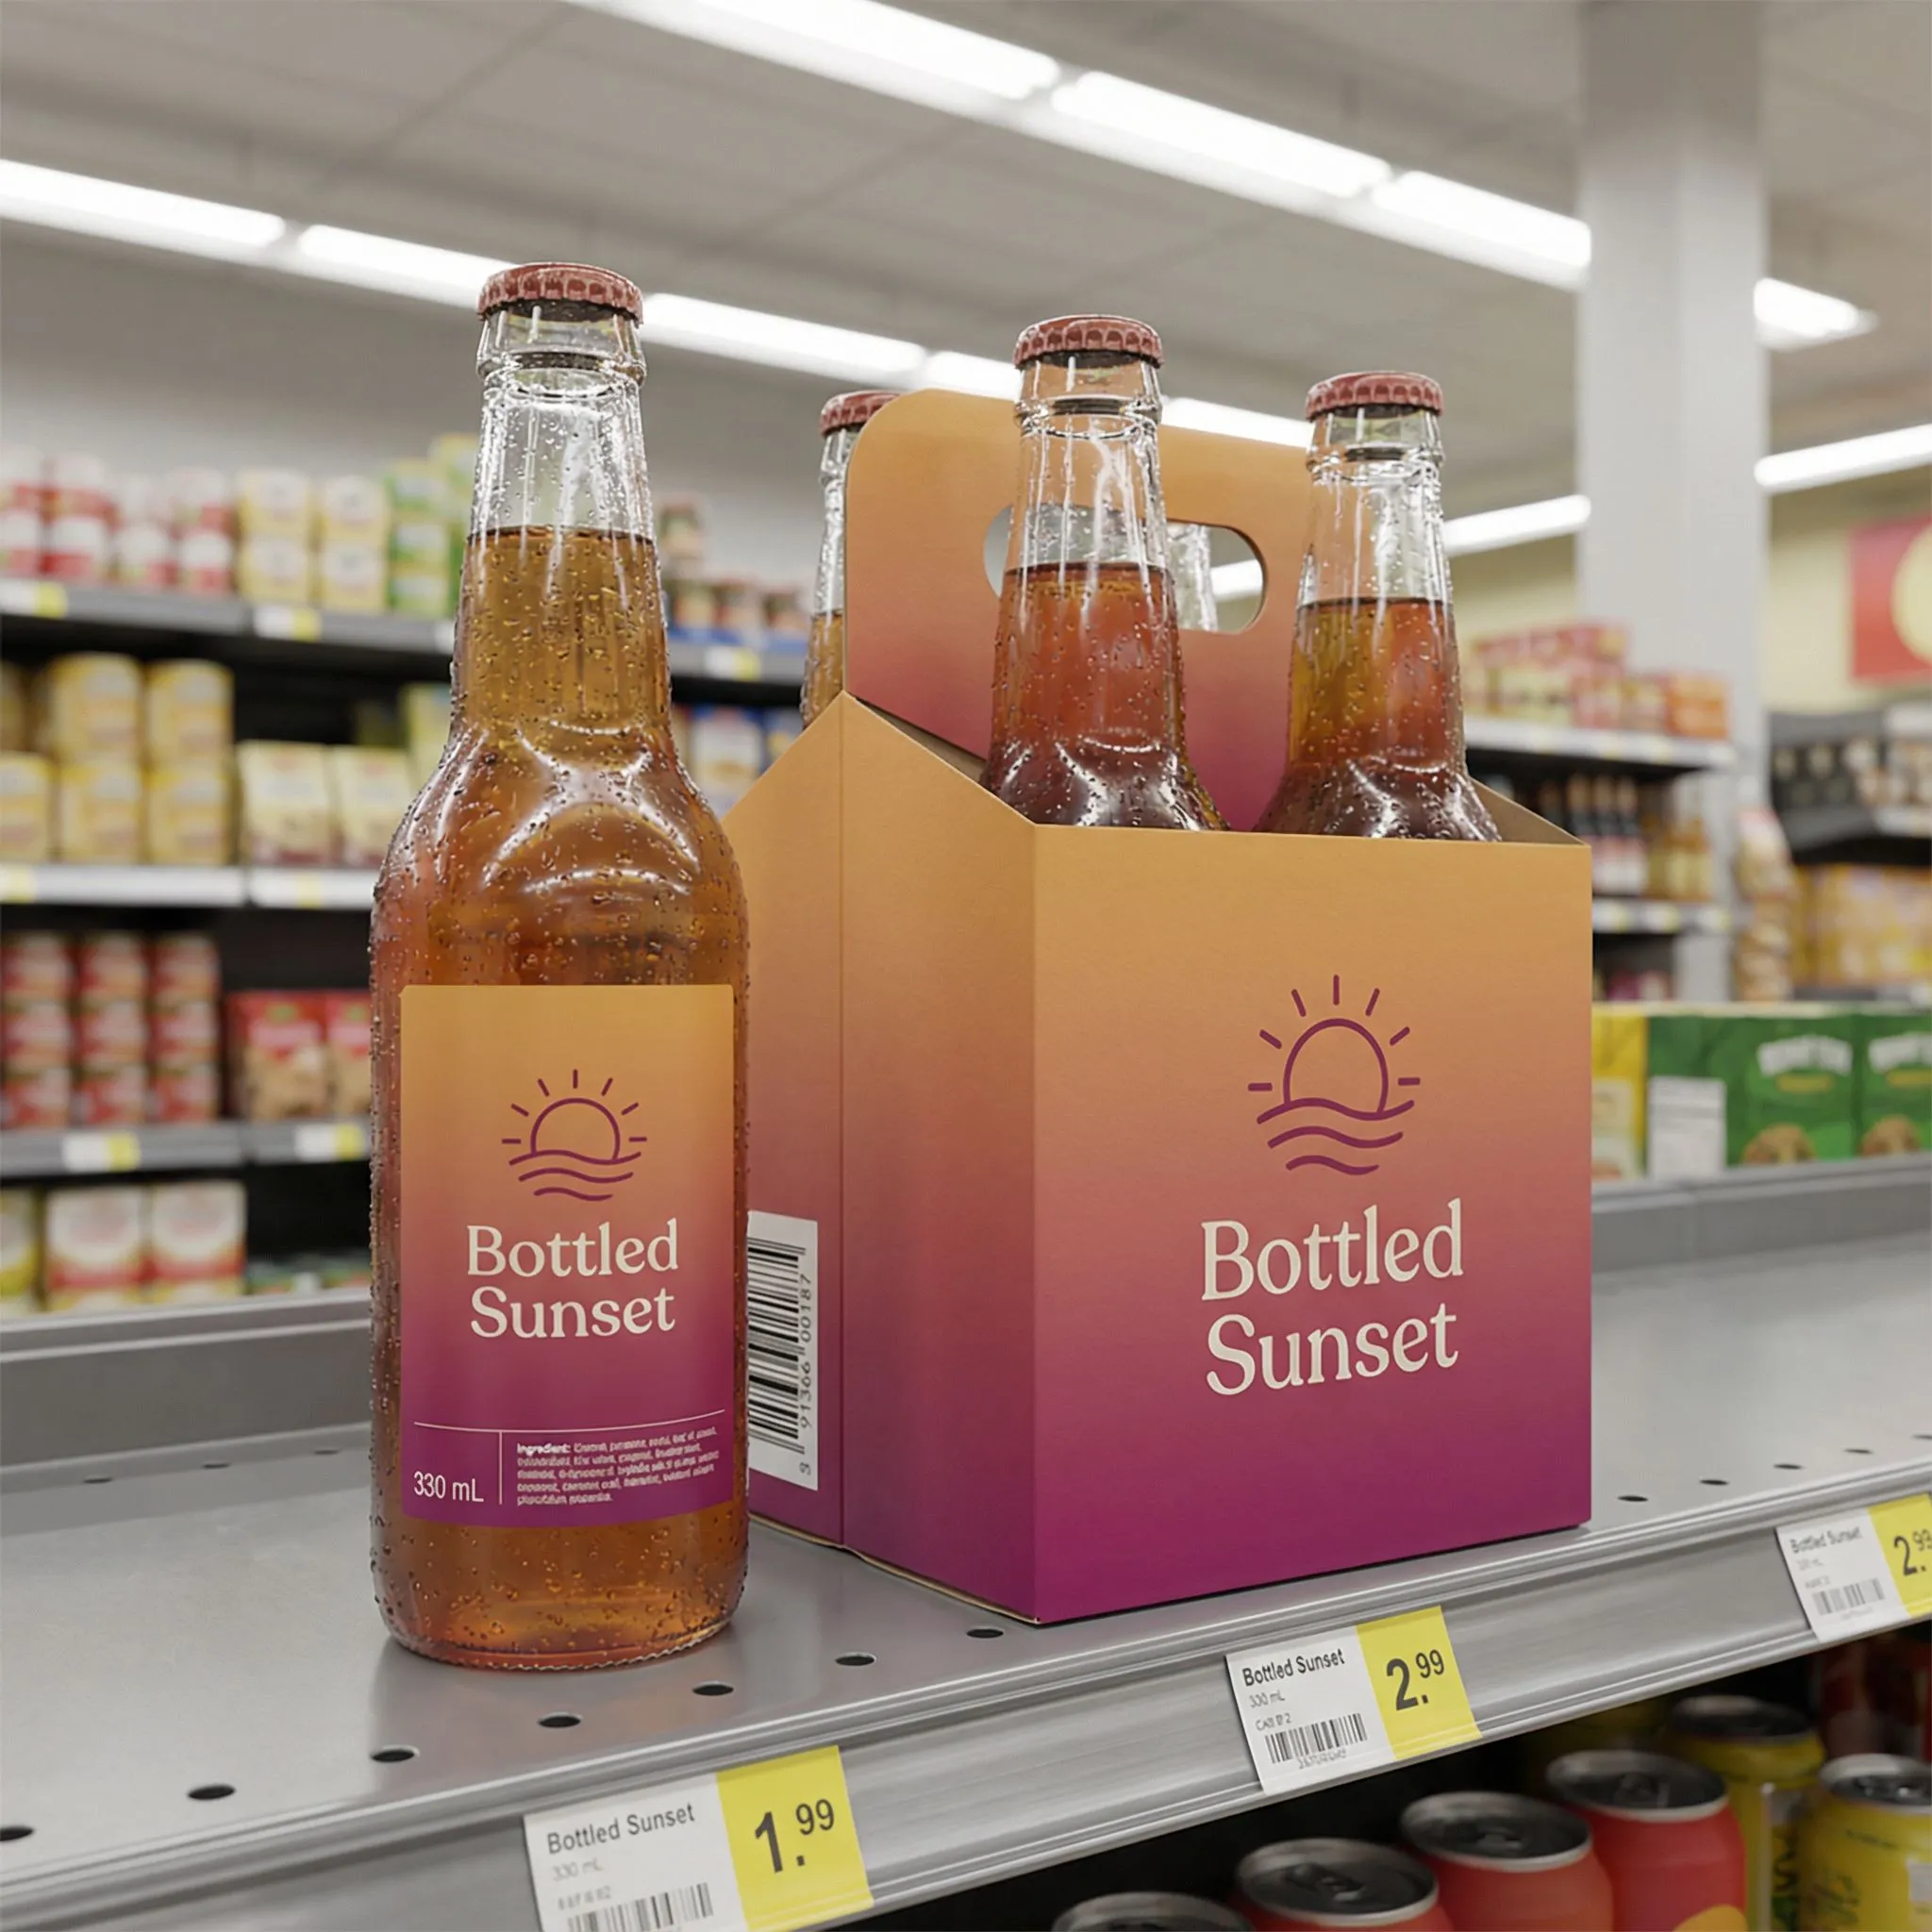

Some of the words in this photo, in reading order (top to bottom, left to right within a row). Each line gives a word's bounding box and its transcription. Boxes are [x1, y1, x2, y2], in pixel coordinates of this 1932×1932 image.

[466, 1217, 679, 1277] Bottled
[1200, 1196, 1464, 1302] Bottled
[470, 1285, 676, 1339] Sunset
[800, 1273, 812, 1343] 00187
[1206, 1302, 1459, 1396] Sunset
[800, 1360, 812, 1428] 91366
[413, 1471, 446, 1499] 330
[452, 1477, 485, 1503] mL
[1241, 1658, 1294, 1687] Bottled
[1295, 1648, 1345, 1674] Sunset
[546, 1819, 622, 1855] Bottled
[626, 1803, 695, 1836] Sunset
